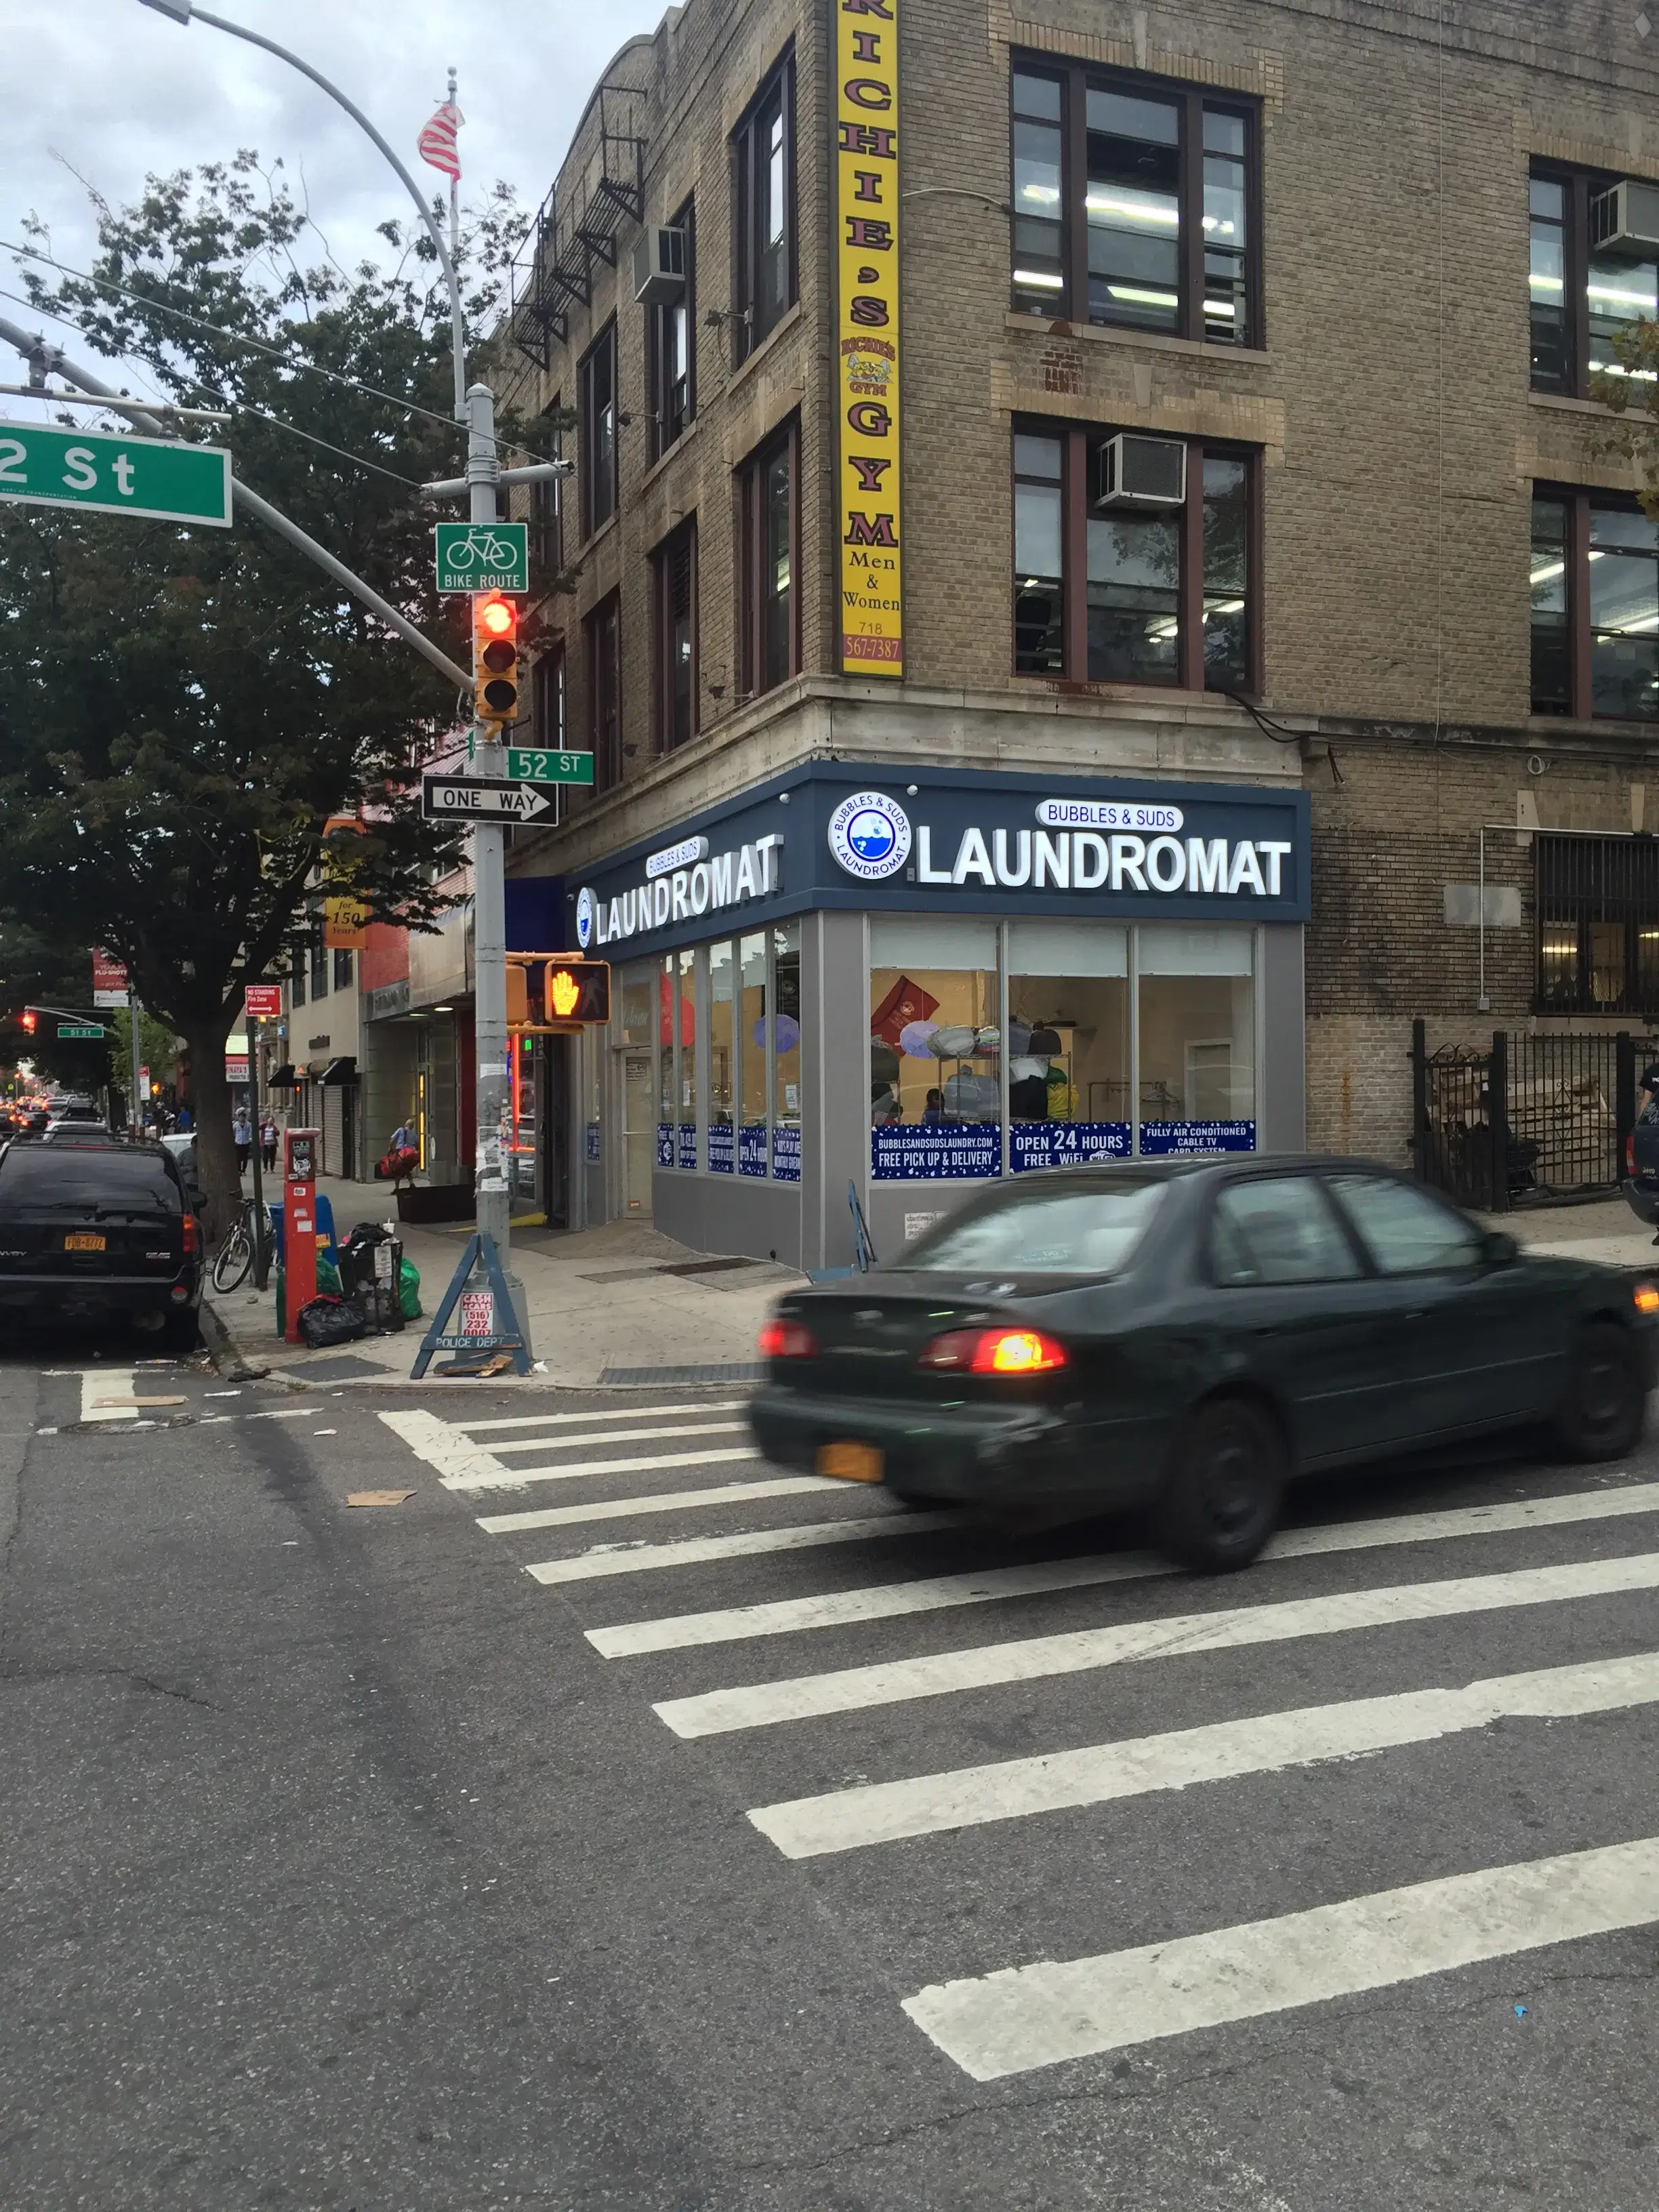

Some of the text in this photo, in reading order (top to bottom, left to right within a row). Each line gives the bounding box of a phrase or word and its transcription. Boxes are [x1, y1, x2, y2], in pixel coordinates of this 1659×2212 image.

[849, 381, 887, 396] GYM
[62, 447, 135, 495] St
[844, 401, 899, 548] GYM
[848, 551, 895, 570] Men
[445, 574, 520, 588] BIKE ROUTE
[867, 574, 879, 590] &
[843, 591, 901, 611] Women
[859, 621, 883, 635] 718
[846, 636, 899, 659] 567-7387
[519, 752, 581, 778] 52 ST
[444, 790, 538, 811] ONE WAY
[834, 795, 907, 832] BUBBLES & SUDS
[1048, 804, 1174, 827] BUBBLES & SUDS
[682, 841, 698, 861] SUDS
[837, 844, 906, 876] LAUNDROMAT
[916, 825, 1292, 895] LAUNDROMAT
[596, 834, 781, 945] LAUNDROMAT
[339, 901, 352, 910] for
[333, 912, 361, 924] 150
[1016, 1130, 1124, 1151] OPEN 24 HOURS
[1147, 1127, 1246, 1137] FULLY AIR CONDITIONED
[750, 1139, 757, 1162] 24
[878, 1137, 993, 1149] BUBBLESANDSUDSLAUNDRY.COM
[1177, 1138, 1217, 1147] CABLE TV
[879, 1151, 994, 1167] FREE PICK UP & DELIVERY
[1024, 1153, 1083, 1166] FREE WiFi
[466, 1311, 489, 1320] (516)
[466, 1320, 488, 1329] 232
[436, 1337, 472, 1348] POLICE
